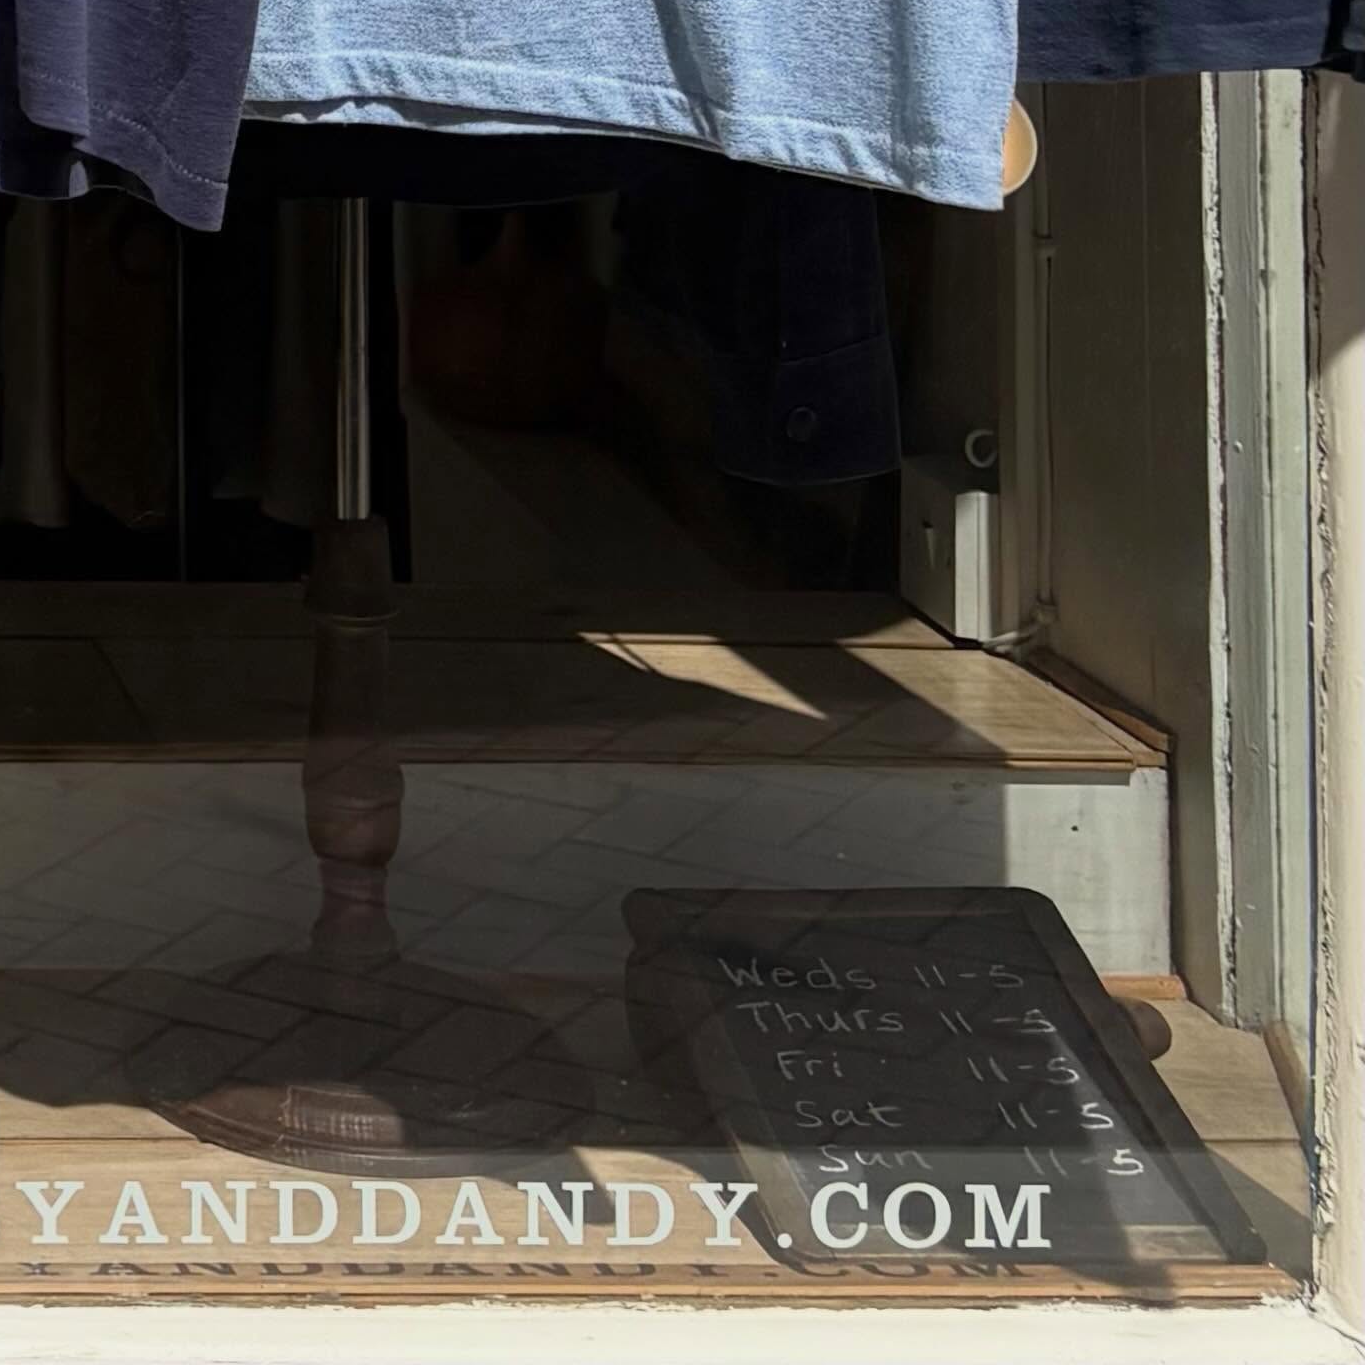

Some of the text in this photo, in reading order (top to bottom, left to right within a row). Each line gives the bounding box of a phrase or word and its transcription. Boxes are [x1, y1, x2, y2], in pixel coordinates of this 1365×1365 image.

[718, 957, 876, 990] Weds
[735, 1001, 905, 1035] Thurs
[795, 1101, 903, 1129] Sat
[818, 1144, 932, 1173] Sun
